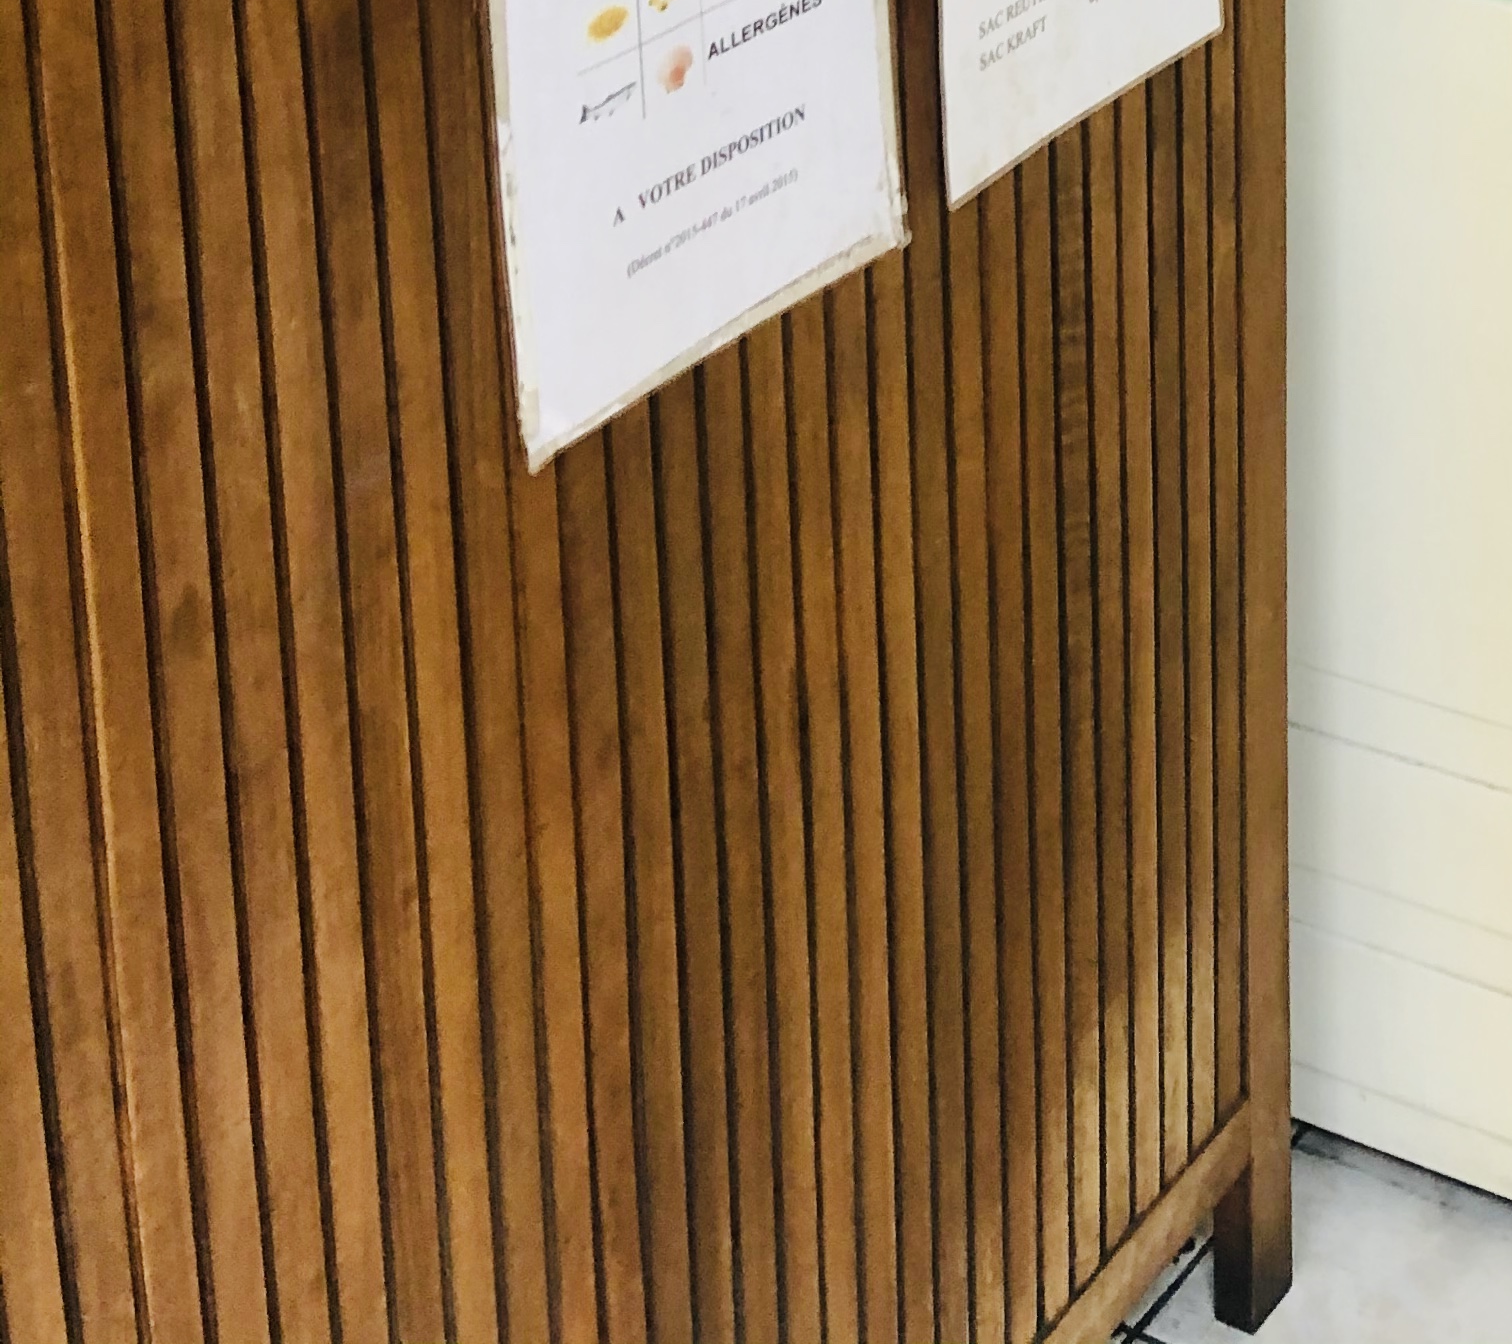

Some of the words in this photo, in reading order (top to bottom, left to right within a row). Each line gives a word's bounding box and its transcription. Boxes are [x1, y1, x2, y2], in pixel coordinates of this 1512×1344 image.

[978, 9, 1005, 41] SAC
[978, 42, 1005, 73] SAC
[1006, 14, 1048, 55] KRAFT
[637, 162, 698, 210] VOTRE
[699, 103, 807, 178] DISPOSITION
